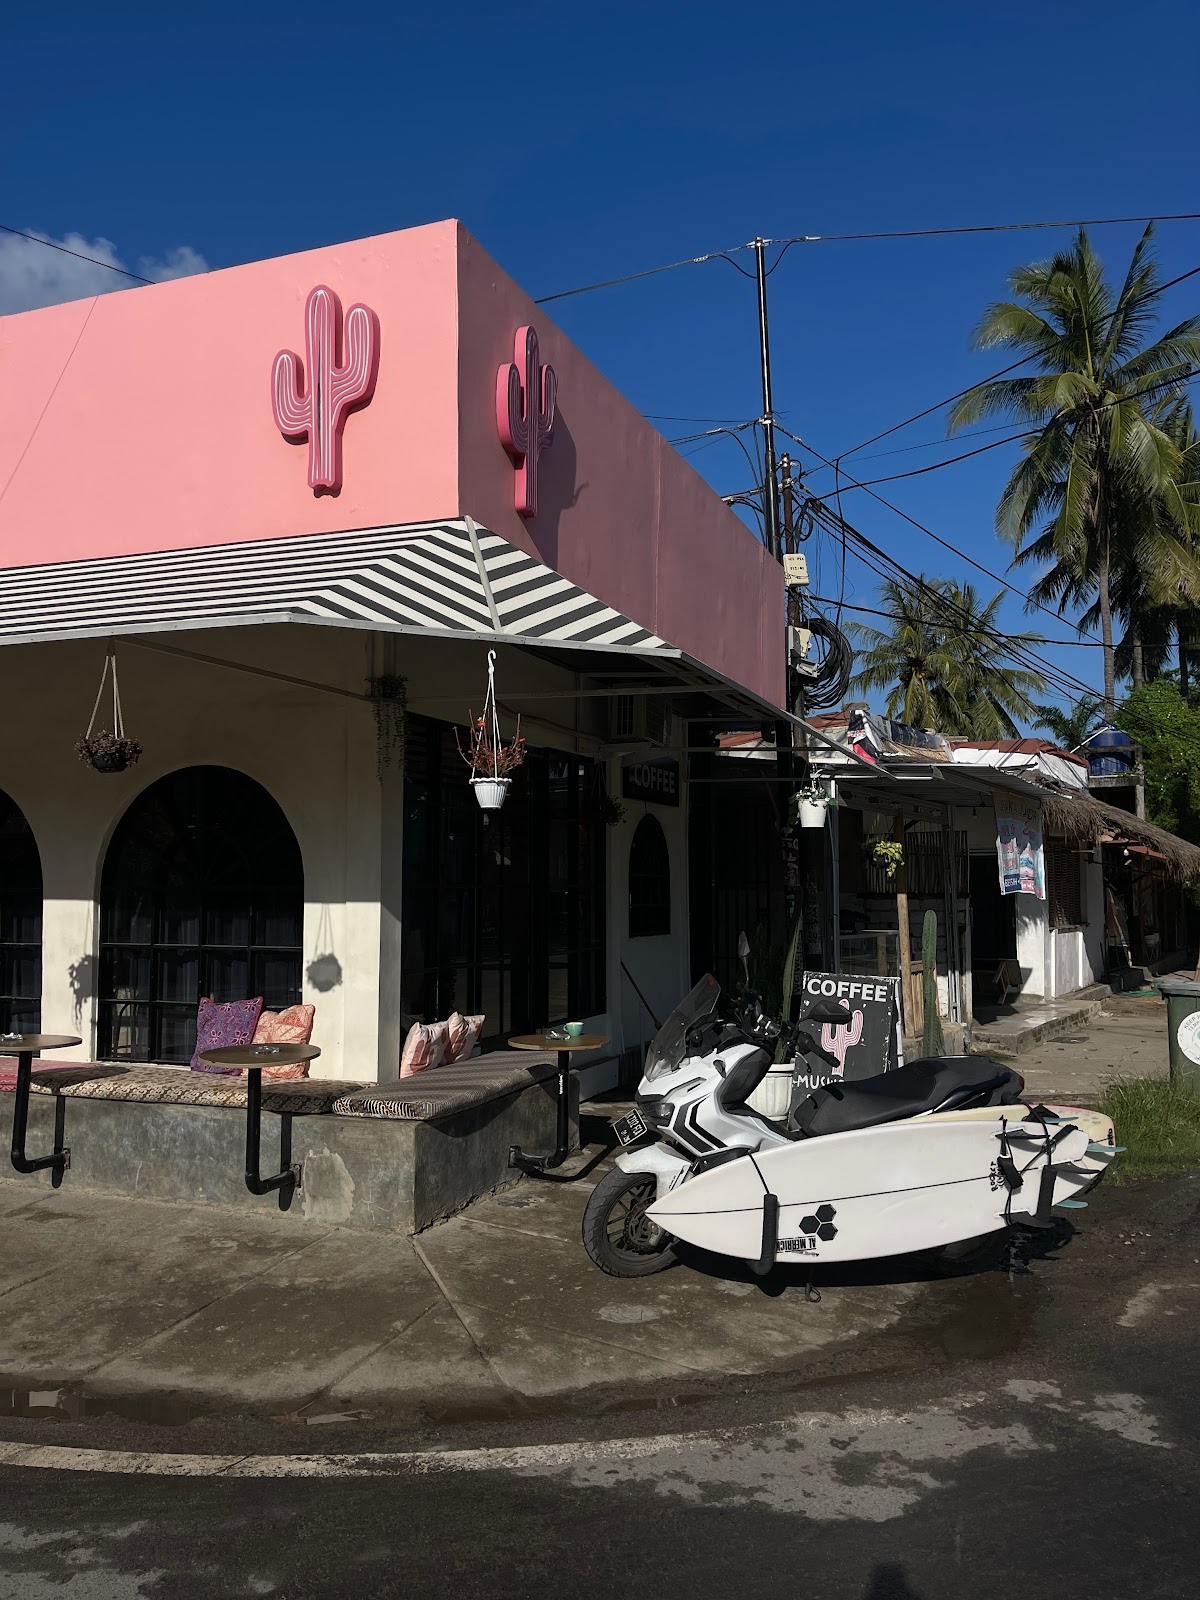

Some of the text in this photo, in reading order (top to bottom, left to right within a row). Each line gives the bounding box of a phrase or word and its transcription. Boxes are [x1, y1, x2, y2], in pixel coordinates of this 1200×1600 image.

[634, 764, 676, 793] COFFEE
[807, 979, 888, 1003] COFFEE
[808, 1237, 816, 1249] AL
